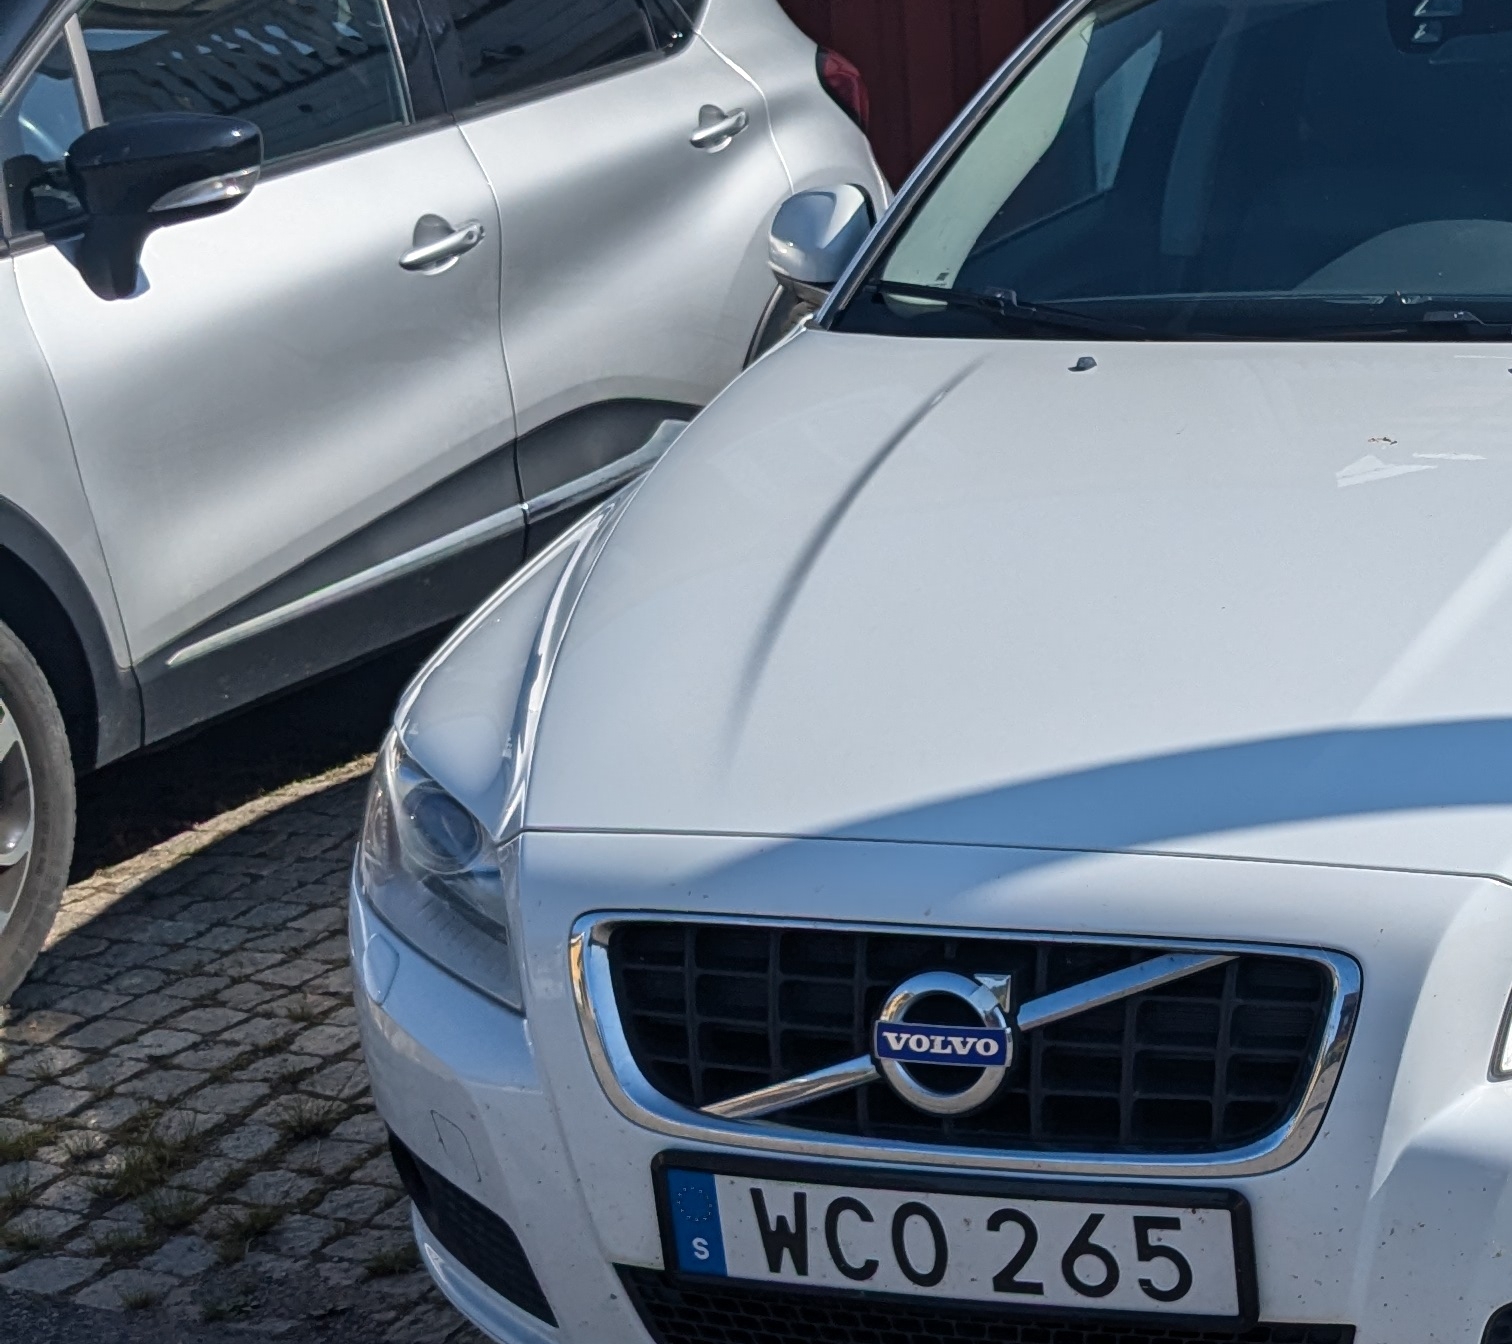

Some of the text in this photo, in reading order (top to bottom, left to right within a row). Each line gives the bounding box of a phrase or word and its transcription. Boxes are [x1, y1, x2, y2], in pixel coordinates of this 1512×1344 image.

[882, 1031, 999, 1056] VOLVO
[691, 1237, 710, 1260] S
[750, 1187, 1193, 1302] WCO 265
